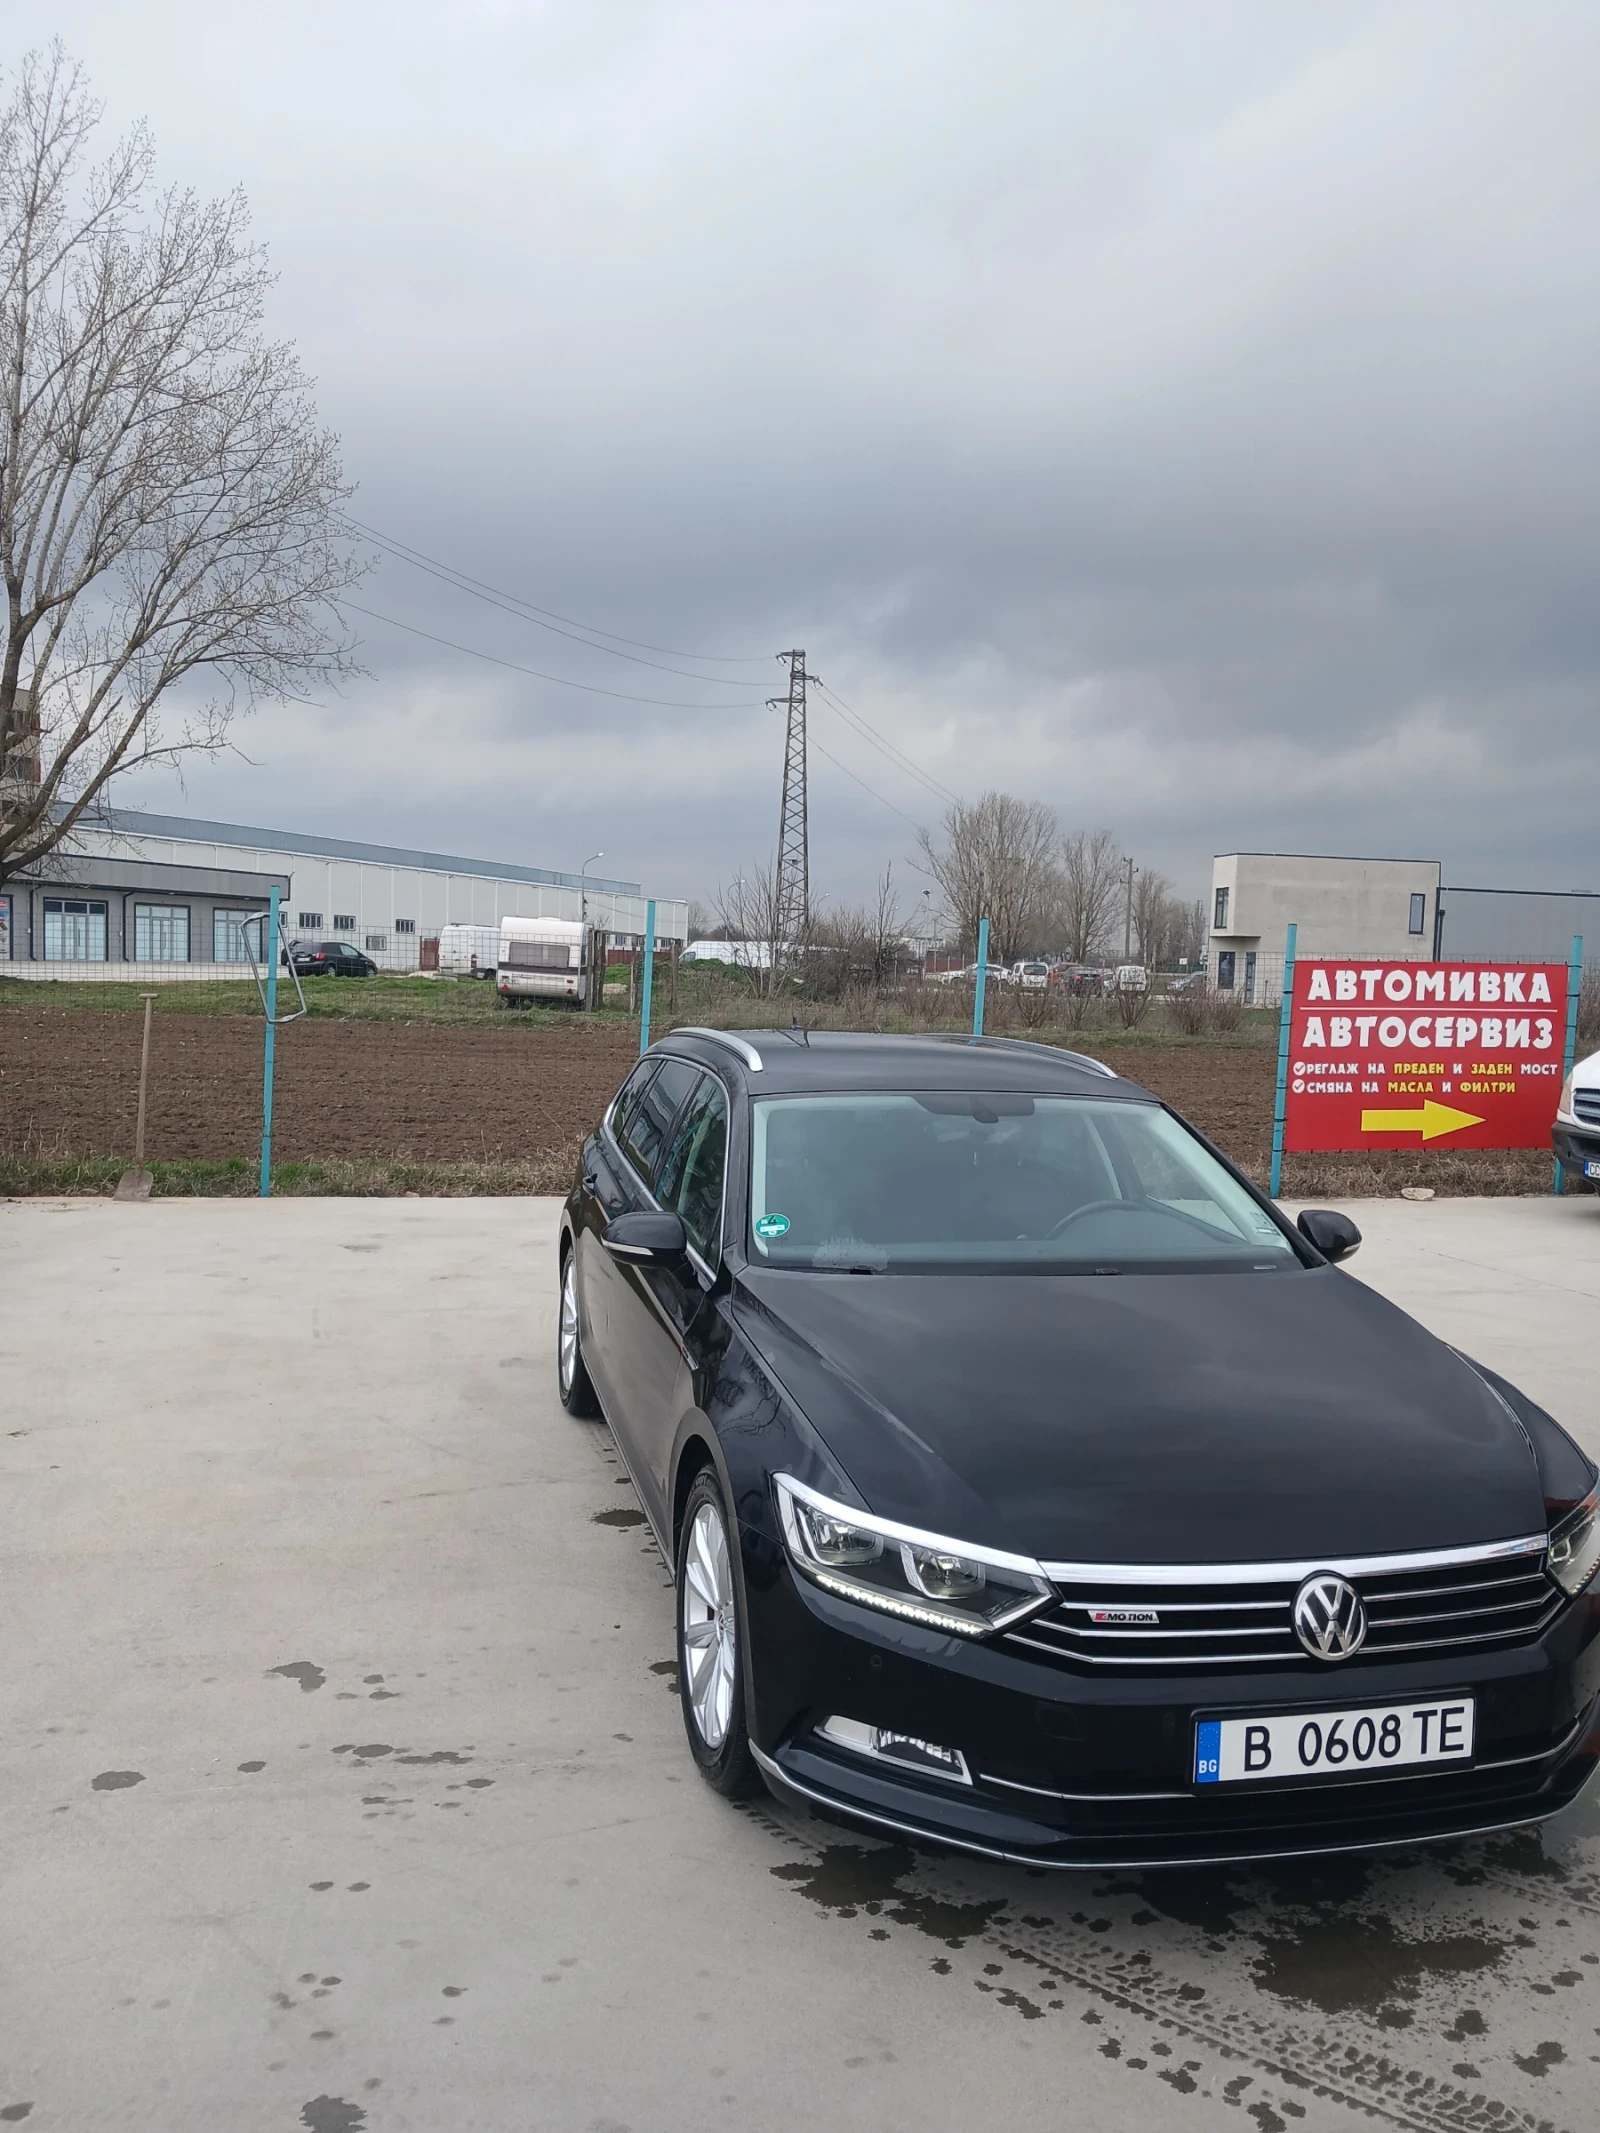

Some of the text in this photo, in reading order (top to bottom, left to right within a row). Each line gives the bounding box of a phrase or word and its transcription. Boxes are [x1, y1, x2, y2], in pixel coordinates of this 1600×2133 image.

[1308, 969, 1551, 1003] АВТОМИВКА
[1302, 1016, 1553, 1049] АВТОСЕРВИЗ
[1307, 1063, 1557, 1075] РЕГЛАЖ НА ПРЕДЕН И ЗАДЕН МОСТ
[1307, 1082, 1515, 1093] СМЯНА НА МАСЛА И ФИЛТРИ
[1244, 1707, 1465, 1772] B 0608 TE
[1199, 1760, 1217, 1774] BG
